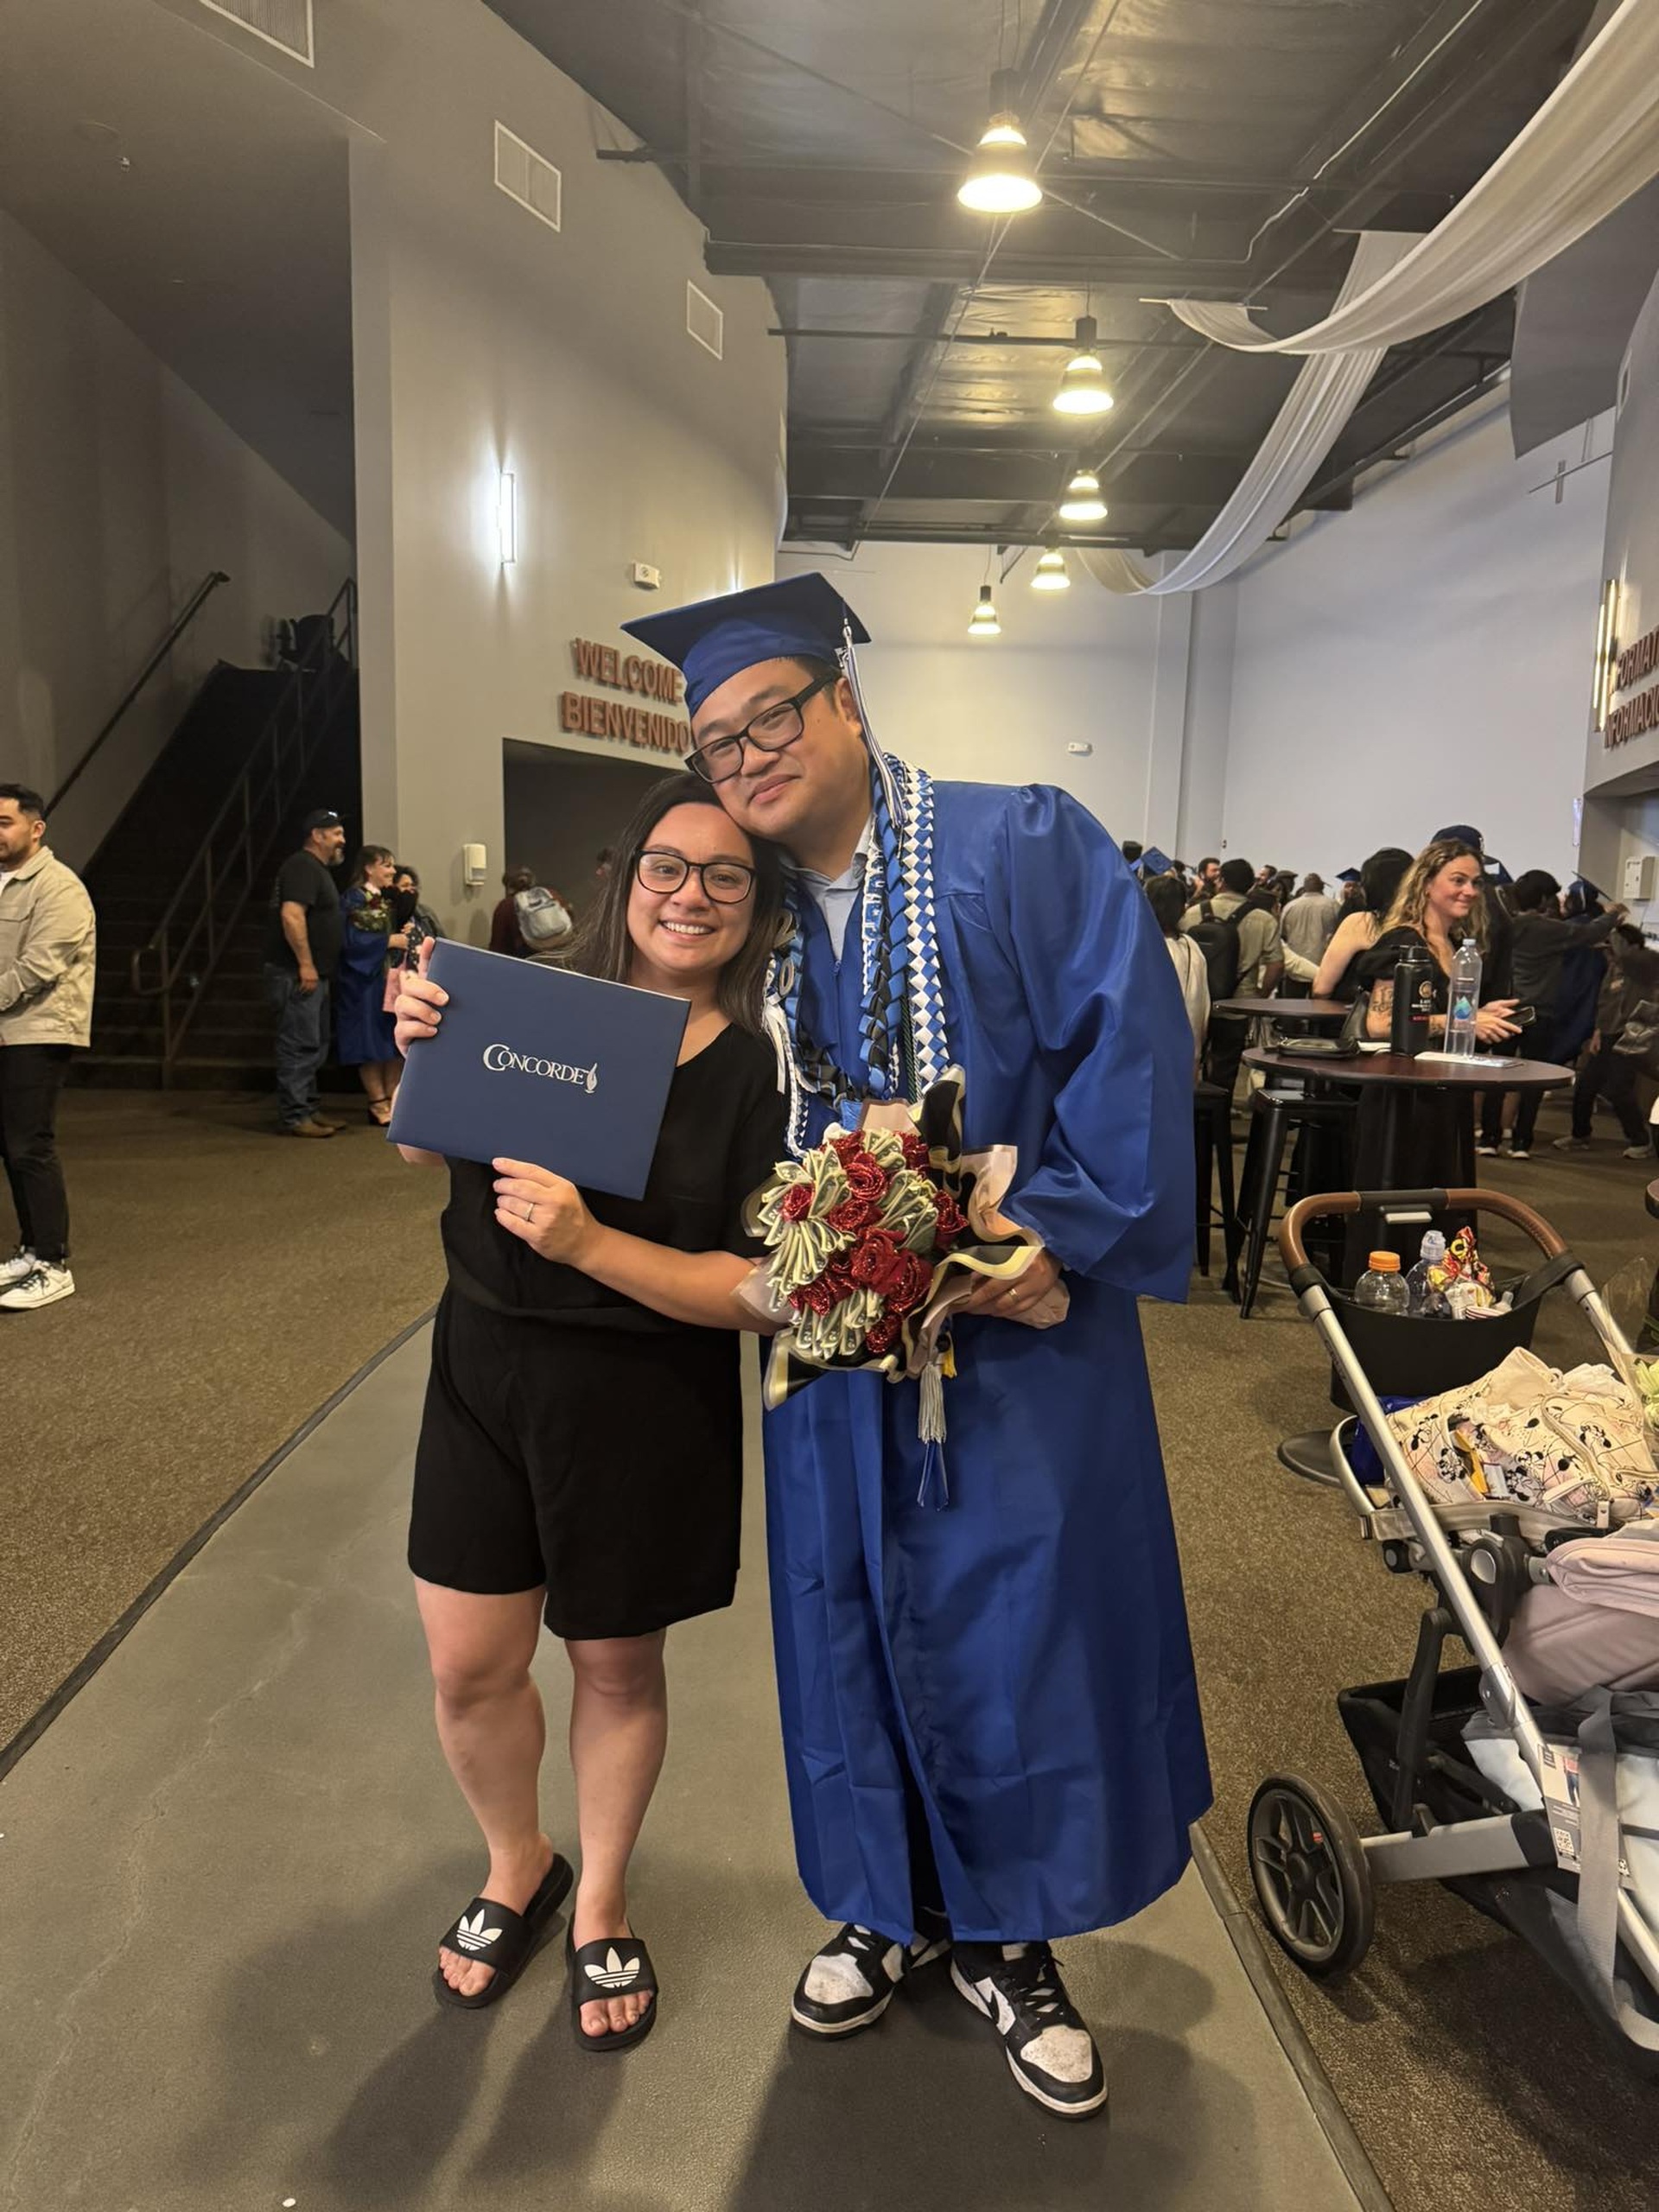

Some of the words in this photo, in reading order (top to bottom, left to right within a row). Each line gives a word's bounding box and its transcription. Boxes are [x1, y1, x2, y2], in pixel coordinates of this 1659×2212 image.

[573, 638, 683, 703] WELCOME
[563, 690, 690, 753] BIENVENIDO
[483, 1044, 588, 1085] CONCORDE
